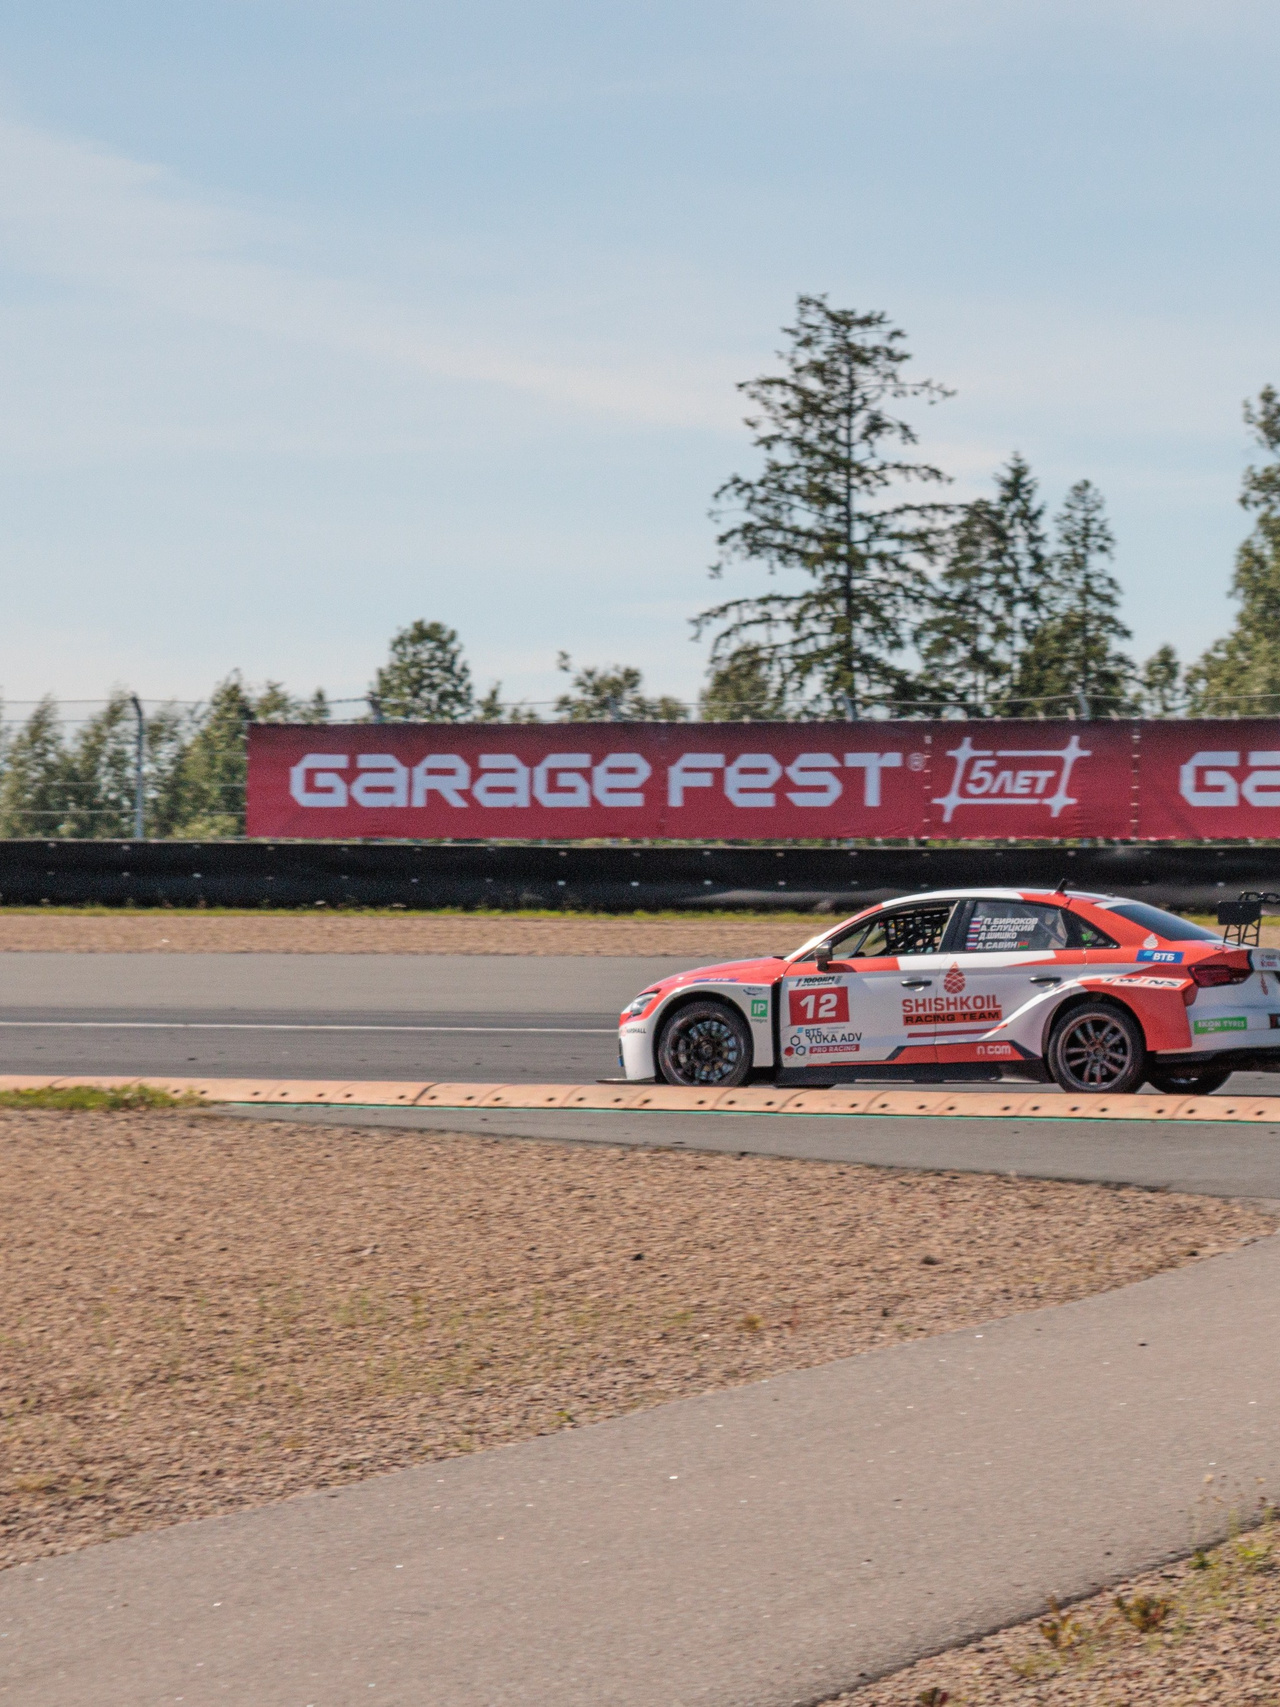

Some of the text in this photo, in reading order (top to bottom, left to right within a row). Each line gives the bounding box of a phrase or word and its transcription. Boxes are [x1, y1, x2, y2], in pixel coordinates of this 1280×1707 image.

[1152, 952, 1176, 962] ВТБ
[753, 1003, 766, 1014] IP
[800, 994, 838, 1019] 12
[902, 995, 1002, 1013] SHISHKOIL
[905, 1012, 999, 1023] RACING TEAM
[840, 1032, 862, 1043] ADV
